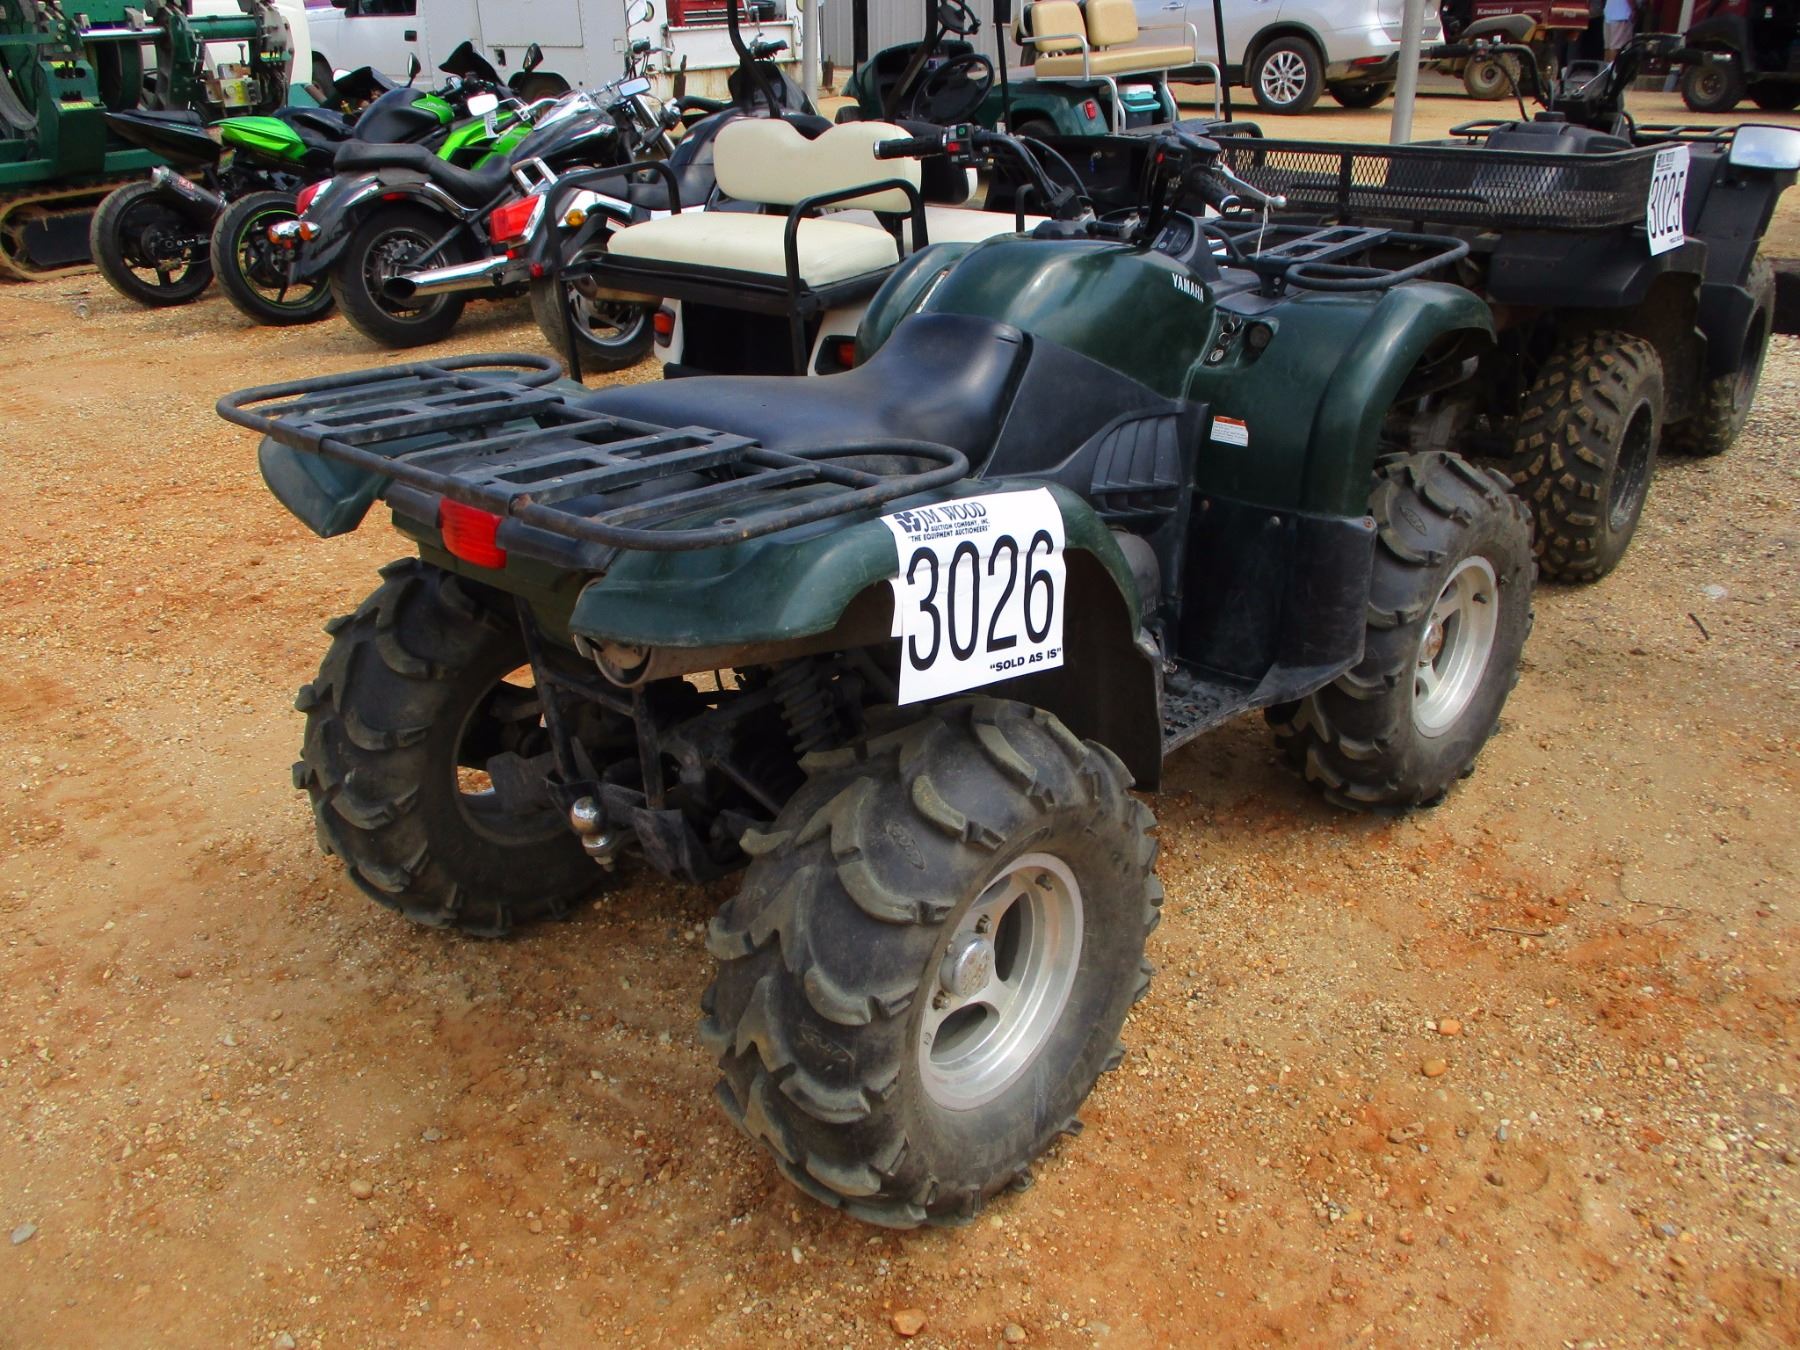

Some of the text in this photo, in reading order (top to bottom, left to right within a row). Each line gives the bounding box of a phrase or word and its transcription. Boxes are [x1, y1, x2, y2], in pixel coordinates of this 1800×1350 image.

[1477, 7, 1513, 15] Kawasaki
[1649, 170, 1685, 240] 3025
[1171, 272, 1204, 304] YAMAHA
[915, 502, 986, 533] JM WOOD
[931, 523, 953, 532] AUCTION
[923, 530, 953, 541] EQUIPMENT
[906, 529, 1054, 671] 3026
[989, 647, 1062, 672] "SOLD AS IS"
